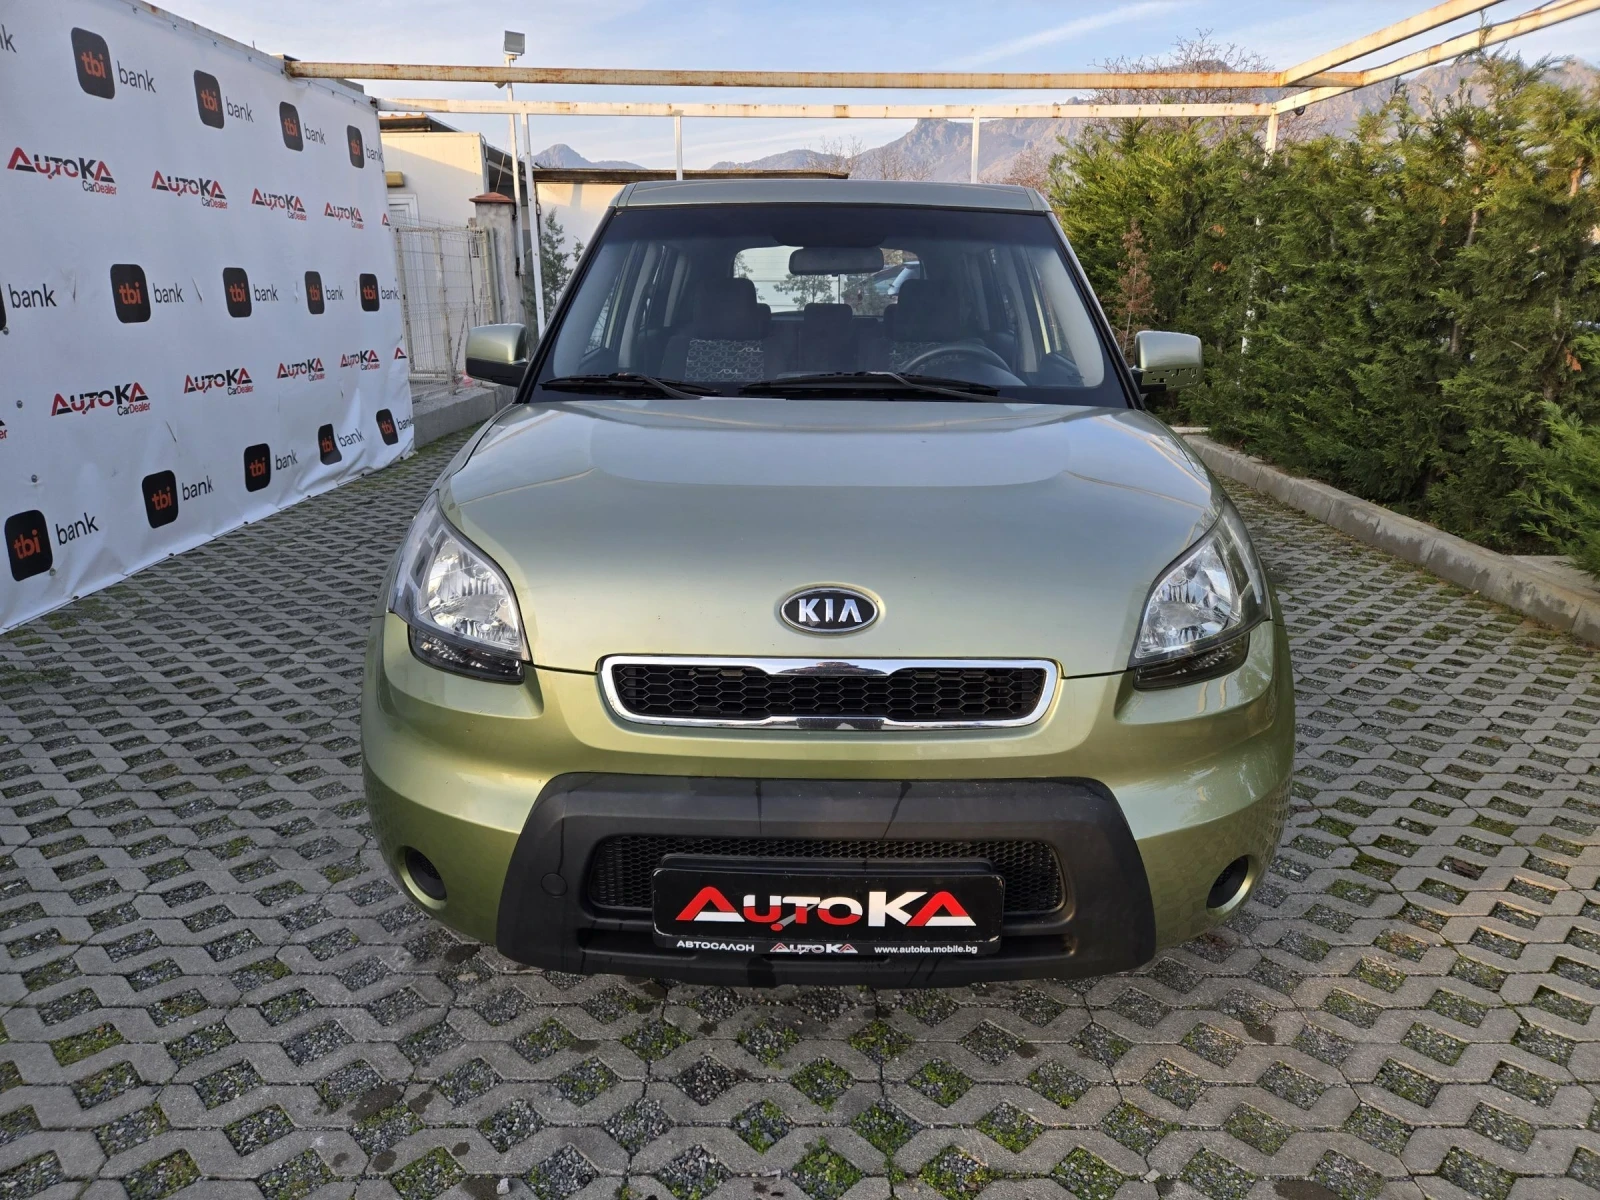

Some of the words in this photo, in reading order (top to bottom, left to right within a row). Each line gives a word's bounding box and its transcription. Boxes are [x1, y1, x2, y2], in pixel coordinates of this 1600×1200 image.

[81, 51, 106, 79] tbi
[117, 60, 156, 93] bank
[200, 90, 218, 112] tbi
[225, 96, 254, 122] bank
[284, 118, 298, 137] tbi
[304, 123, 326, 145] bank
[350, 139, 360, 156] tbi
[7, 147, 115, 183] AUTOKA
[151, 170, 227, 200] AUTOKA
[251, 188, 306, 213] AUTOKA
[8, 283, 57, 309] bank
[119, 282, 142, 305] tbi
[152, 283, 184, 304] bank
[229, 282, 246, 303] tbi
[253, 284, 279, 302] bank
[309, 283, 321, 301] tbi
[325, 285, 344, 301] bank
[362, 285, 376, 300] tbi
[380, 286, 400, 301] bank
[184, 367, 252, 394] AUTOKA
[277, 357, 325, 379] AUTOKA
[51, 382, 149, 416] AUTOKA
[321, 435, 333, 452] tbi
[337, 428, 365, 448] bank
[250, 457, 266, 477] tbi
[275, 449, 298, 470] bank
[151, 486, 172, 511] tbi
[181, 475, 214, 501] bank
[13, 528, 41, 560] tbi
[55, 512, 100, 546] bank
[798, 598, 863, 623] KIA
[675, 886, 977, 932] AUTOKA
[676, 940, 755, 952] АВТОСАЛОН
[769, 942, 859, 955] AUTOKA
[874, 944, 978, 955] www.autoka.mobile.bg
